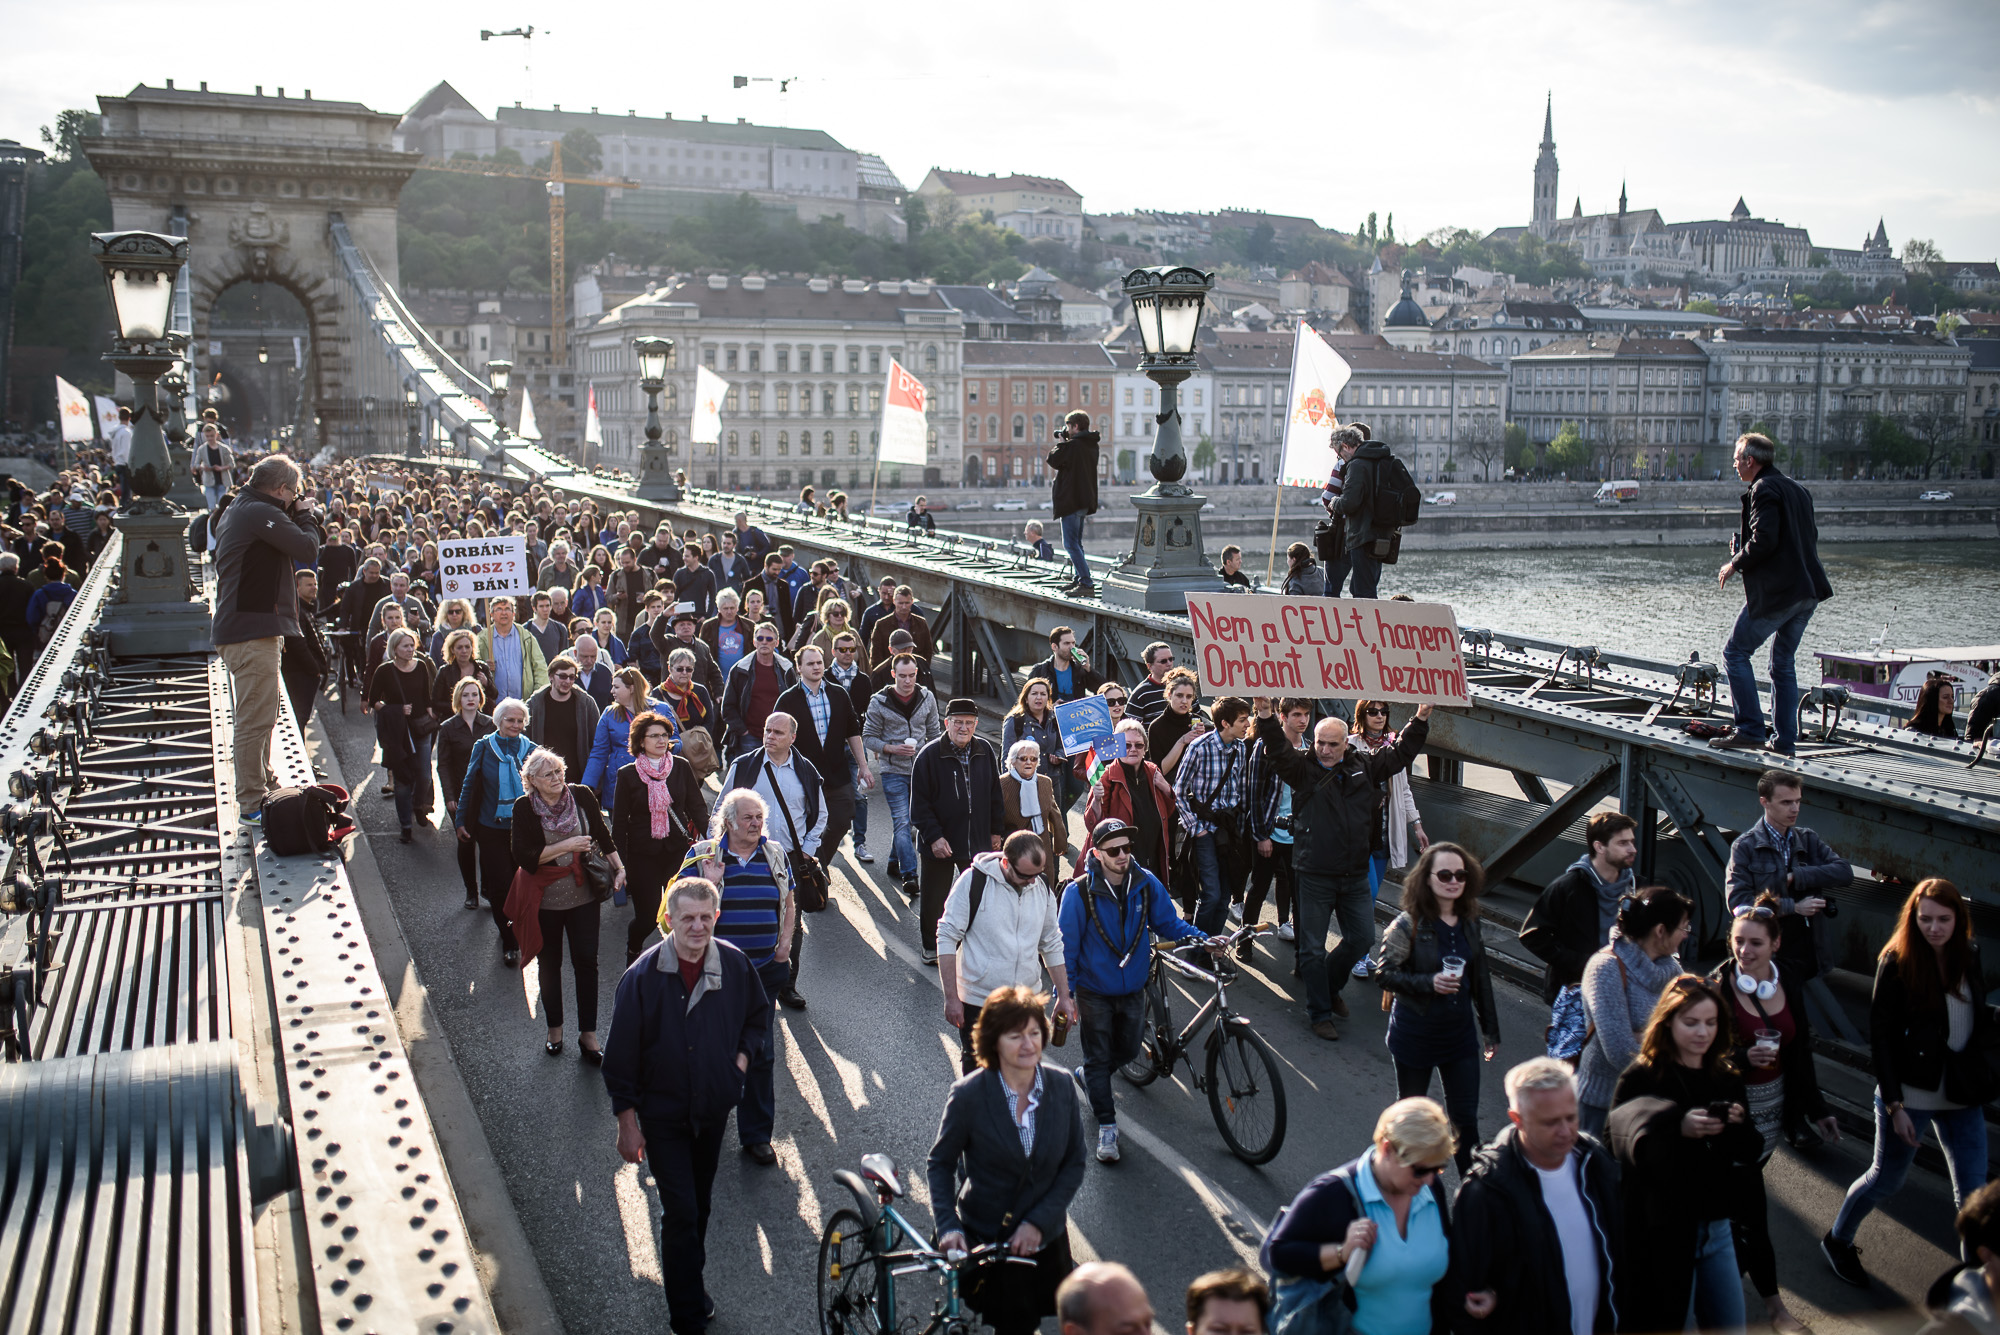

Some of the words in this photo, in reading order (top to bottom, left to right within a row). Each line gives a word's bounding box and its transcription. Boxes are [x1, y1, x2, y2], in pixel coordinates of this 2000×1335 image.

[1072, 312, 1096, 320] HOTEL
[1188, 600, 1255, 643] Nem
[1261, 622, 1280, 644] a
[1375, 608, 1456, 653] hanem
[1203, 643, 1305, 689] Orbánt
[1316, 647, 1365, 691] kell
[1377, 650, 1468, 702] bezárni!
[1070, 708, 1093, 718] CIVIL
[1070, 720, 1102, 732] VAGYOK!
